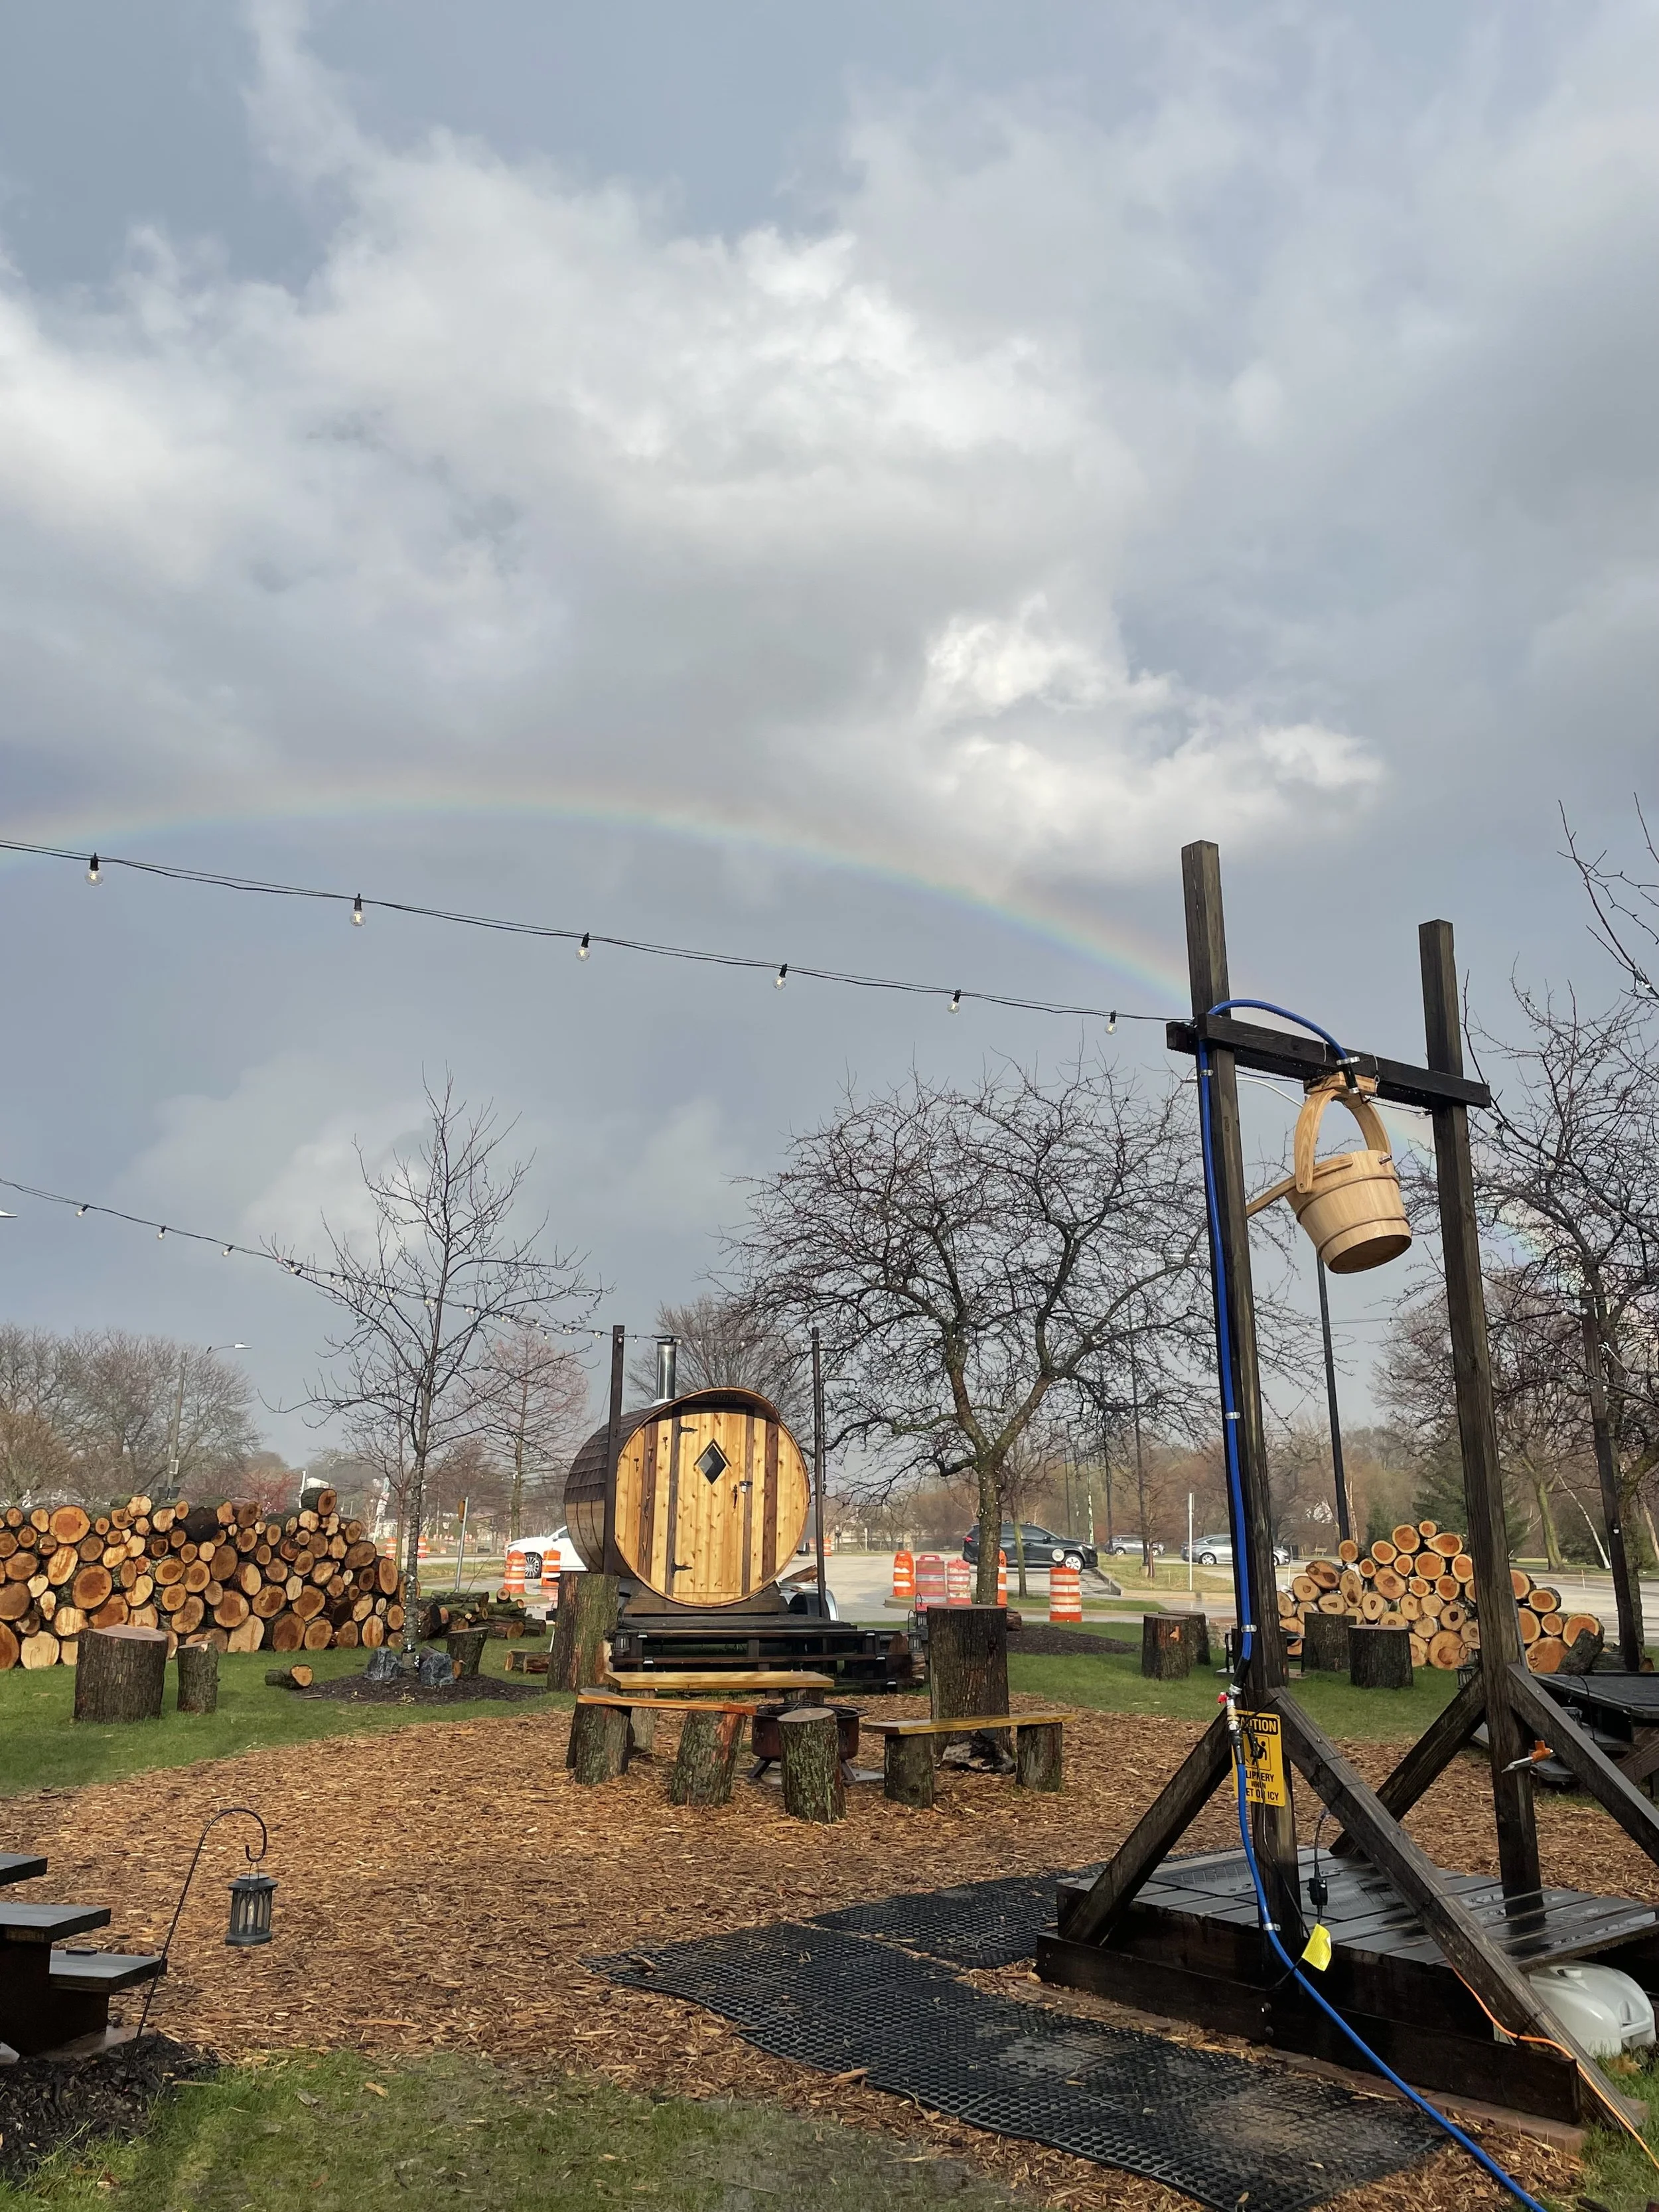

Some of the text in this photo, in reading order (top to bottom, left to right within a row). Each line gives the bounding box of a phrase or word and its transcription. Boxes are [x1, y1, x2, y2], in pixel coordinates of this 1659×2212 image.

[1240, 1717, 1277, 1733] ATION
[1246, 1770, 1274, 1783] LIPERY
[1251, 1781, 1266, 1789] WHN
[1267, 1791, 1279, 1801] ICY
